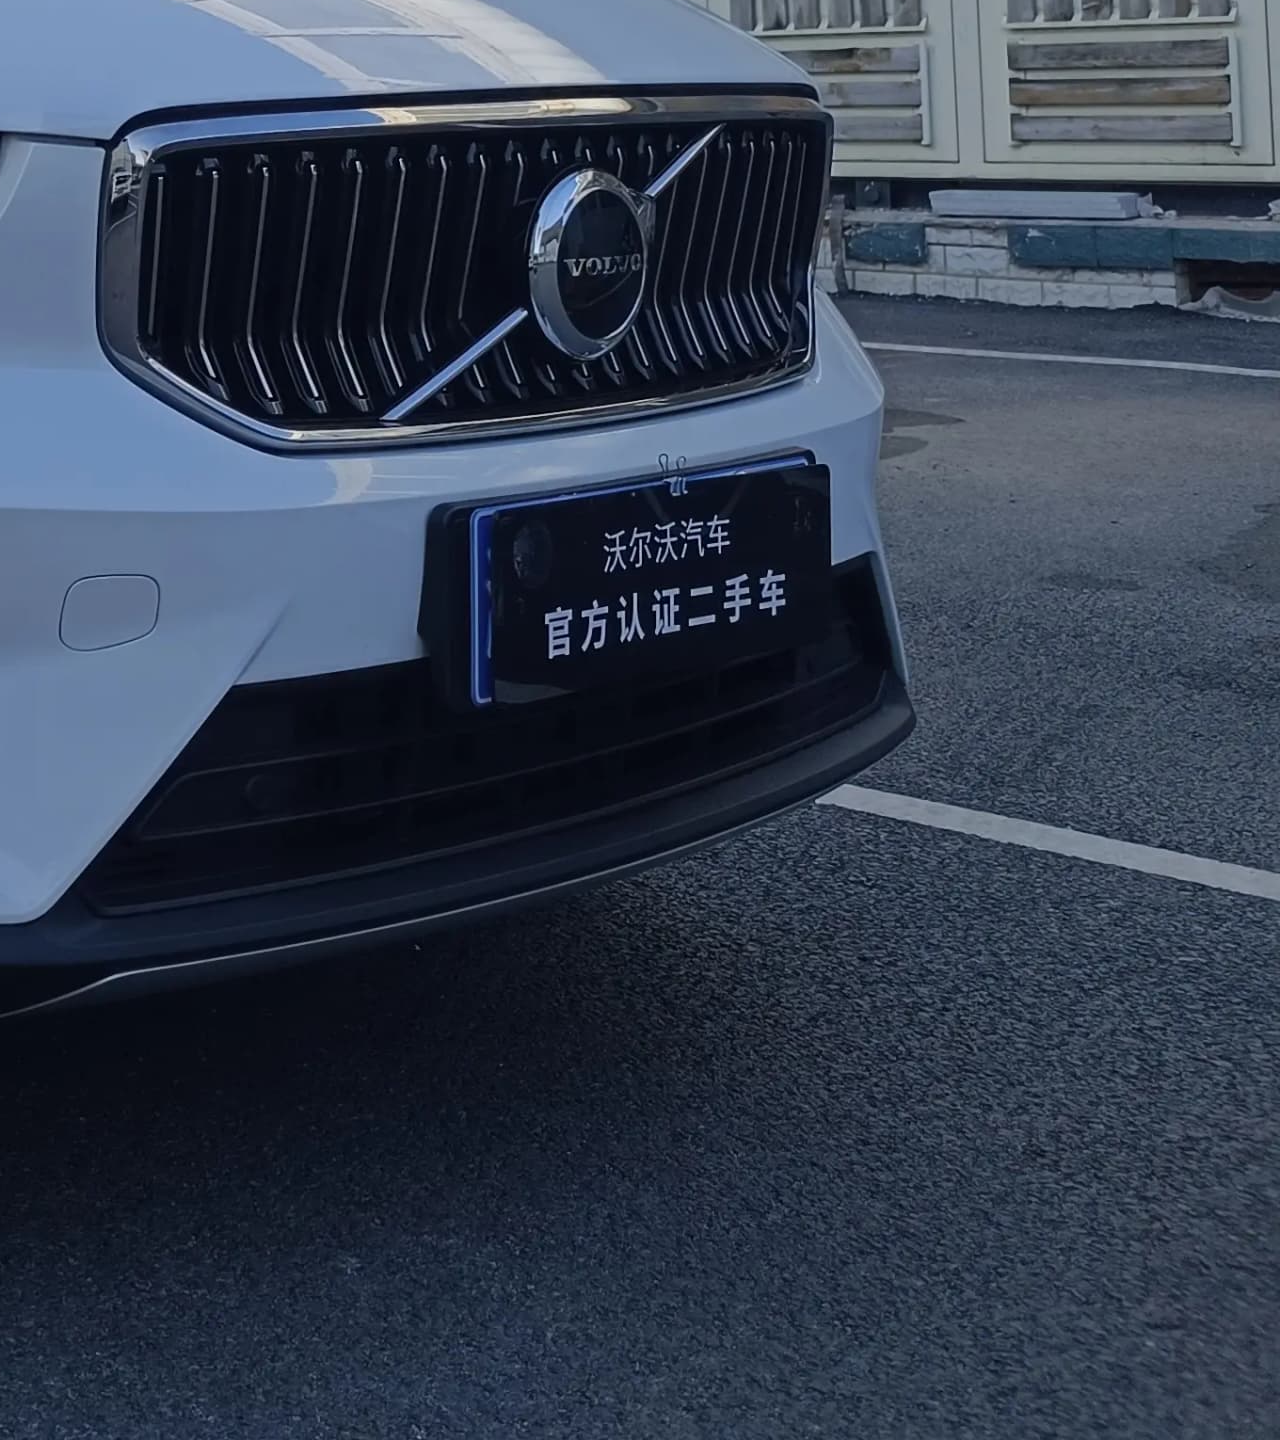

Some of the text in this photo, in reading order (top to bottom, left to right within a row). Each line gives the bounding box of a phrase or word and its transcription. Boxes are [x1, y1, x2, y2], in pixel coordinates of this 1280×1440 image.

[563, 253, 641, 277] VOLVO
[603, 514, 731, 574] 沃尔沃汽车
[544, 569, 787, 660] 官方认证二手车
